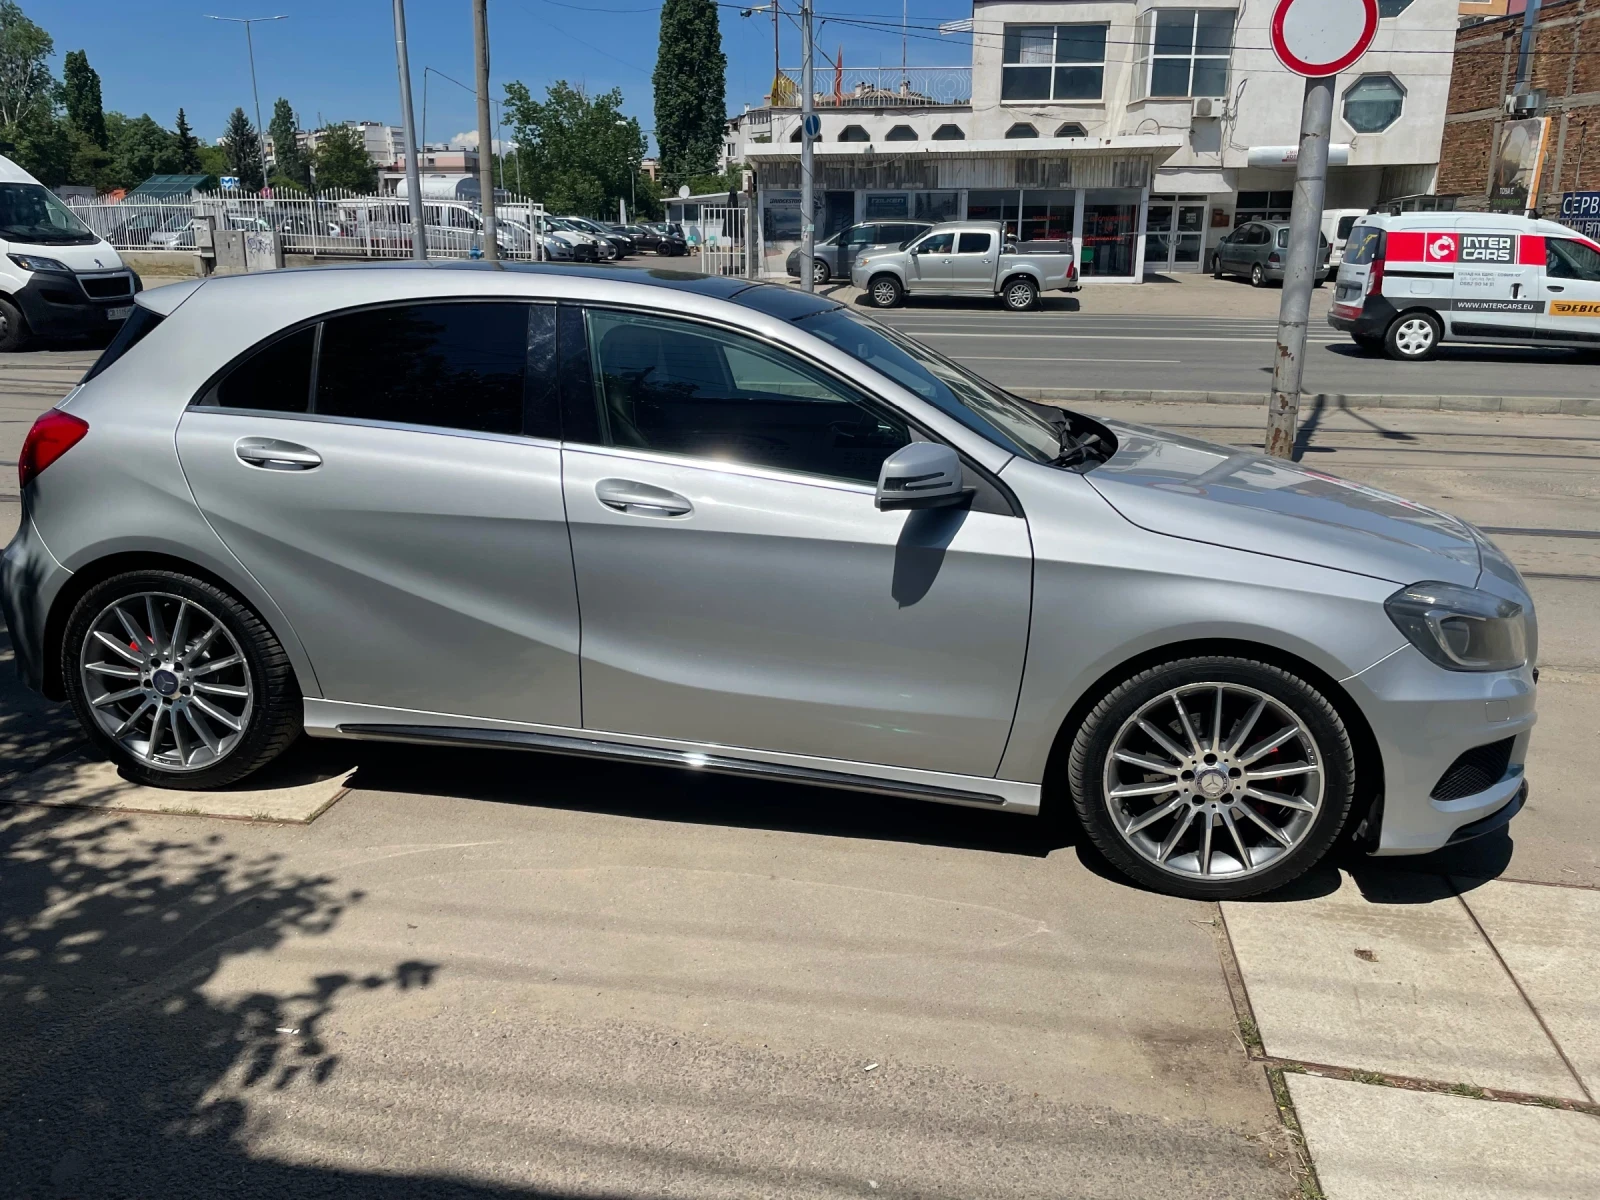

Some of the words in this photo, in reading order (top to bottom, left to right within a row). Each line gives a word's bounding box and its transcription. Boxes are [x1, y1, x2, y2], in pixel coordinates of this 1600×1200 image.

[1563, 196, 1600, 214] СЕРВ
[1463, 236, 1511, 249] INTER
[1462, 248, 1510, 261] CARS
[1457, 301, 1534, 310] WWW.INTERCARS.EU
